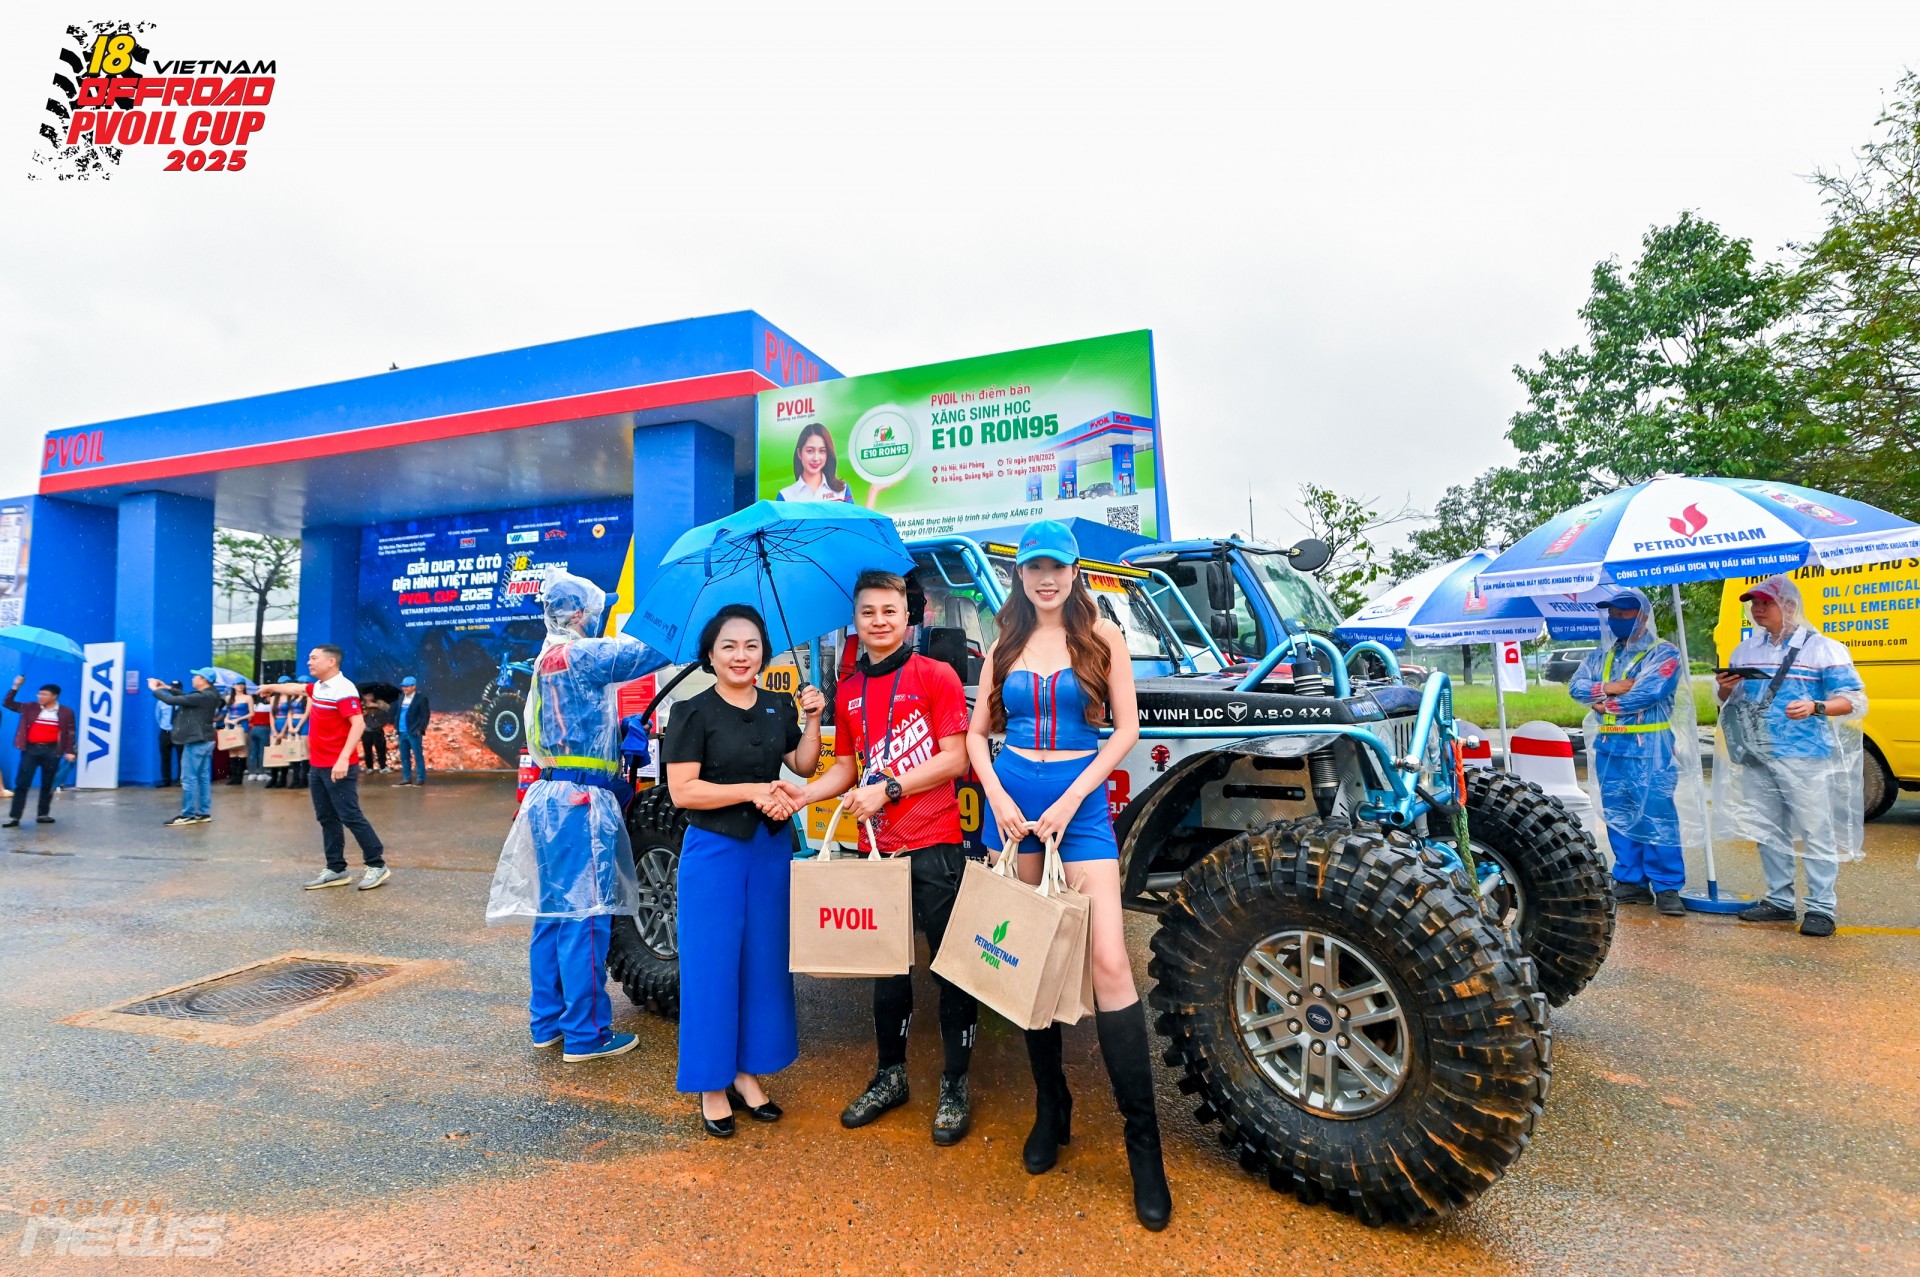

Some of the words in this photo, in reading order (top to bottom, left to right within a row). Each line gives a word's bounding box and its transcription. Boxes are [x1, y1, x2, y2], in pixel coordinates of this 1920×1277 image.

[931, 392, 958, 406] PVOIL
[961, 390, 975, 402] thi
[979, 385, 1006, 399] điểm
[1010, 384, 1031, 396] bán
[777, 398, 815, 417] PVOIL
[932, 409, 966, 425] XĂNG
[969, 404, 1000, 420] SINH
[1004, 400, 1031, 418] HỌC
[932, 425, 973, 450] E10
[981, 414, 1059, 444] RON95
[43, 431, 104, 470] PVOIL
[863, 449, 877, 459] E10
[879, 445, 907, 458] RON95
[1010, 508, 1028, 517] XĂNG
[1030, 508, 1043, 516] E10
[918, 525, 954, 534] 01/01/2026
[1634, 528, 1767, 552] PETROVIETNAM
[457, 558, 474, 571] XE
[476, 553, 502, 570] ÔTÔ
[515, 556, 528, 570] 18
[1616, 569, 1638, 580] CÔNG
[1650, 564, 1662, 576] CỔ
[1663, 562, 1686, 574] PHẦN
[1688, 561, 1707, 572] DỊCH
[1708, 560, 1720, 570] VỤ
[1741, 556, 1756, 566] KHÍ
[1758, 554, 1777, 564] THÁI
[1779, 552, 1800, 562] BÌNH
[412, 574, 439, 589] HÌNH
[441, 572, 468, 589] VIỆT
[470, 571, 498, 585] NAM
[508, 581, 540, 594] PVOIL
[1823, 586, 1840, 598] OIL
[1845, 585, 1850, 596] /
[1854, 580, 1920, 595] CHEMICAL
[434, 590, 458, 603] CUP
[460, 588, 493, 602] 2025
[400, 607, 424, 615] VIETNAM
[1823, 604, 1856, 615] SPILL
[1823, 619, 1889, 632] RESPONSE
[766, 672, 790, 690] 409
[85, 659, 114, 772] VISA
[1154, 709, 1189, 720] VINH
[1195, 709, 1224, 720] LOC
[1254, 708, 1294, 719] A.B.O
[1299, 707, 1332, 718] 4X4
[819, 907, 878, 930] PVOIL
[974, 934, 1019, 968] PETROVIETNAM
[980, 950, 1000, 970] PVOIL
